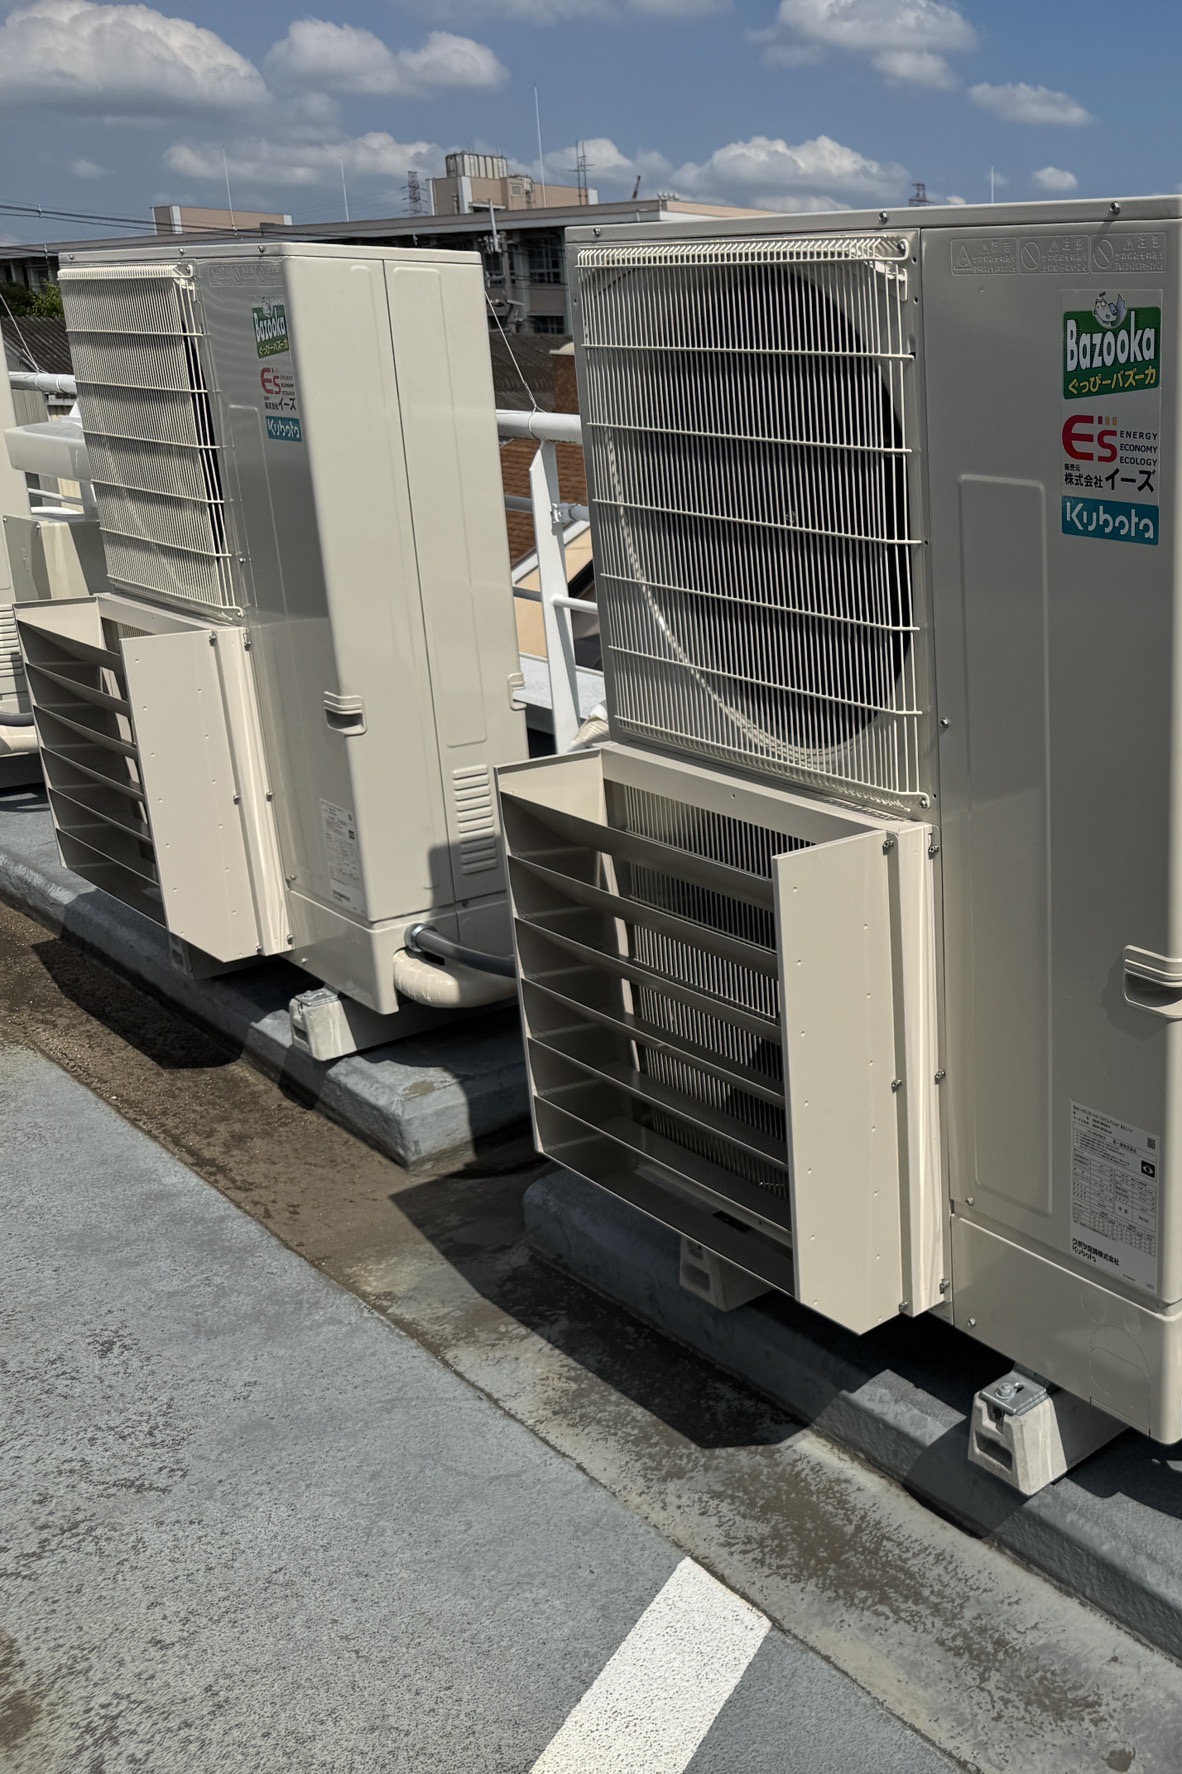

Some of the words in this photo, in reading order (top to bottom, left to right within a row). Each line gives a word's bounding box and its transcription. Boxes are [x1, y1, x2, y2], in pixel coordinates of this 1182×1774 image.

[254, 307, 286, 342] Bazooka
[1067, 310, 1155, 372] Bazooka
[1068, 365, 1156, 394] ぐっぴーバズーカ
[267, 418, 300, 438] Kubota
[1119, 430, 1158, 441] ENERGY
[1119, 443, 1158, 454] ECONOMY
[1119, 456, 1158, 467] ECOLOGY
[1066, 502, 1154, 539] Kubota
